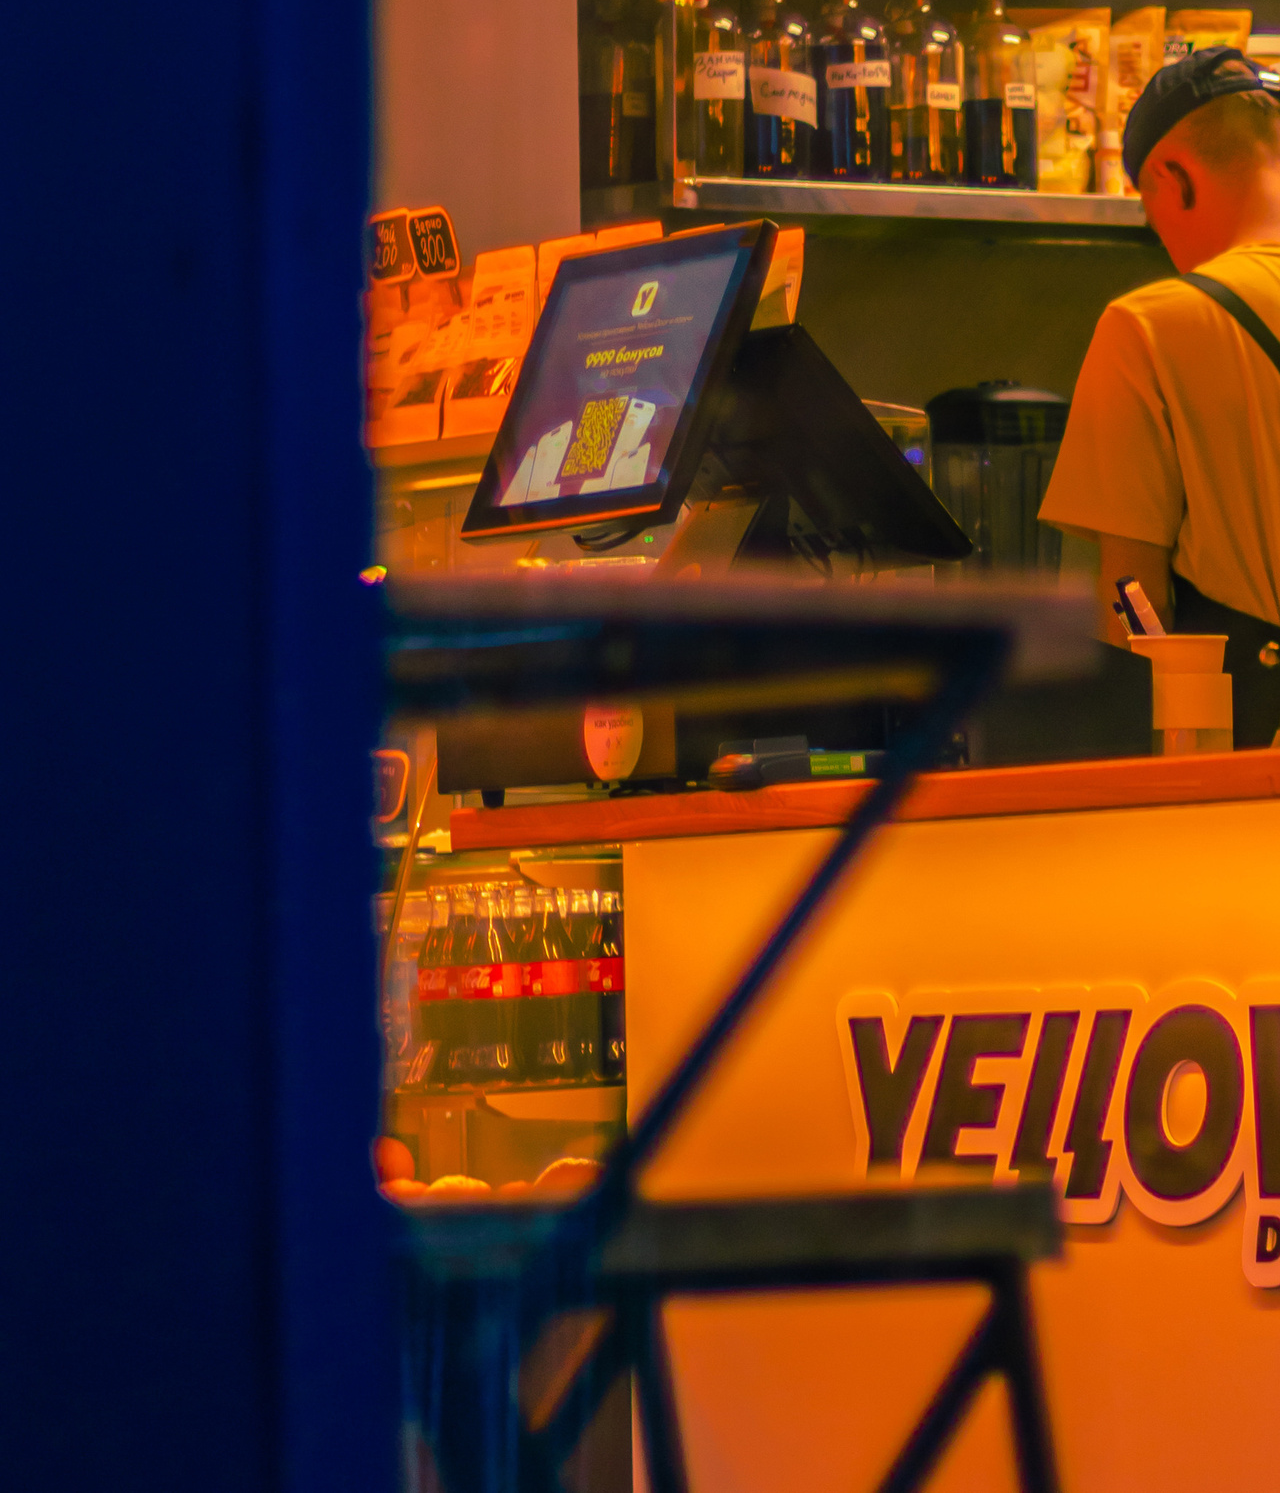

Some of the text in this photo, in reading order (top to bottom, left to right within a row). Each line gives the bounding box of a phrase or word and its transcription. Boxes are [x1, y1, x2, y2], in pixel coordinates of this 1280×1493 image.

[420, 234, 446, 268] 300
[585, 345, 664, 370] 9999 бонусов
